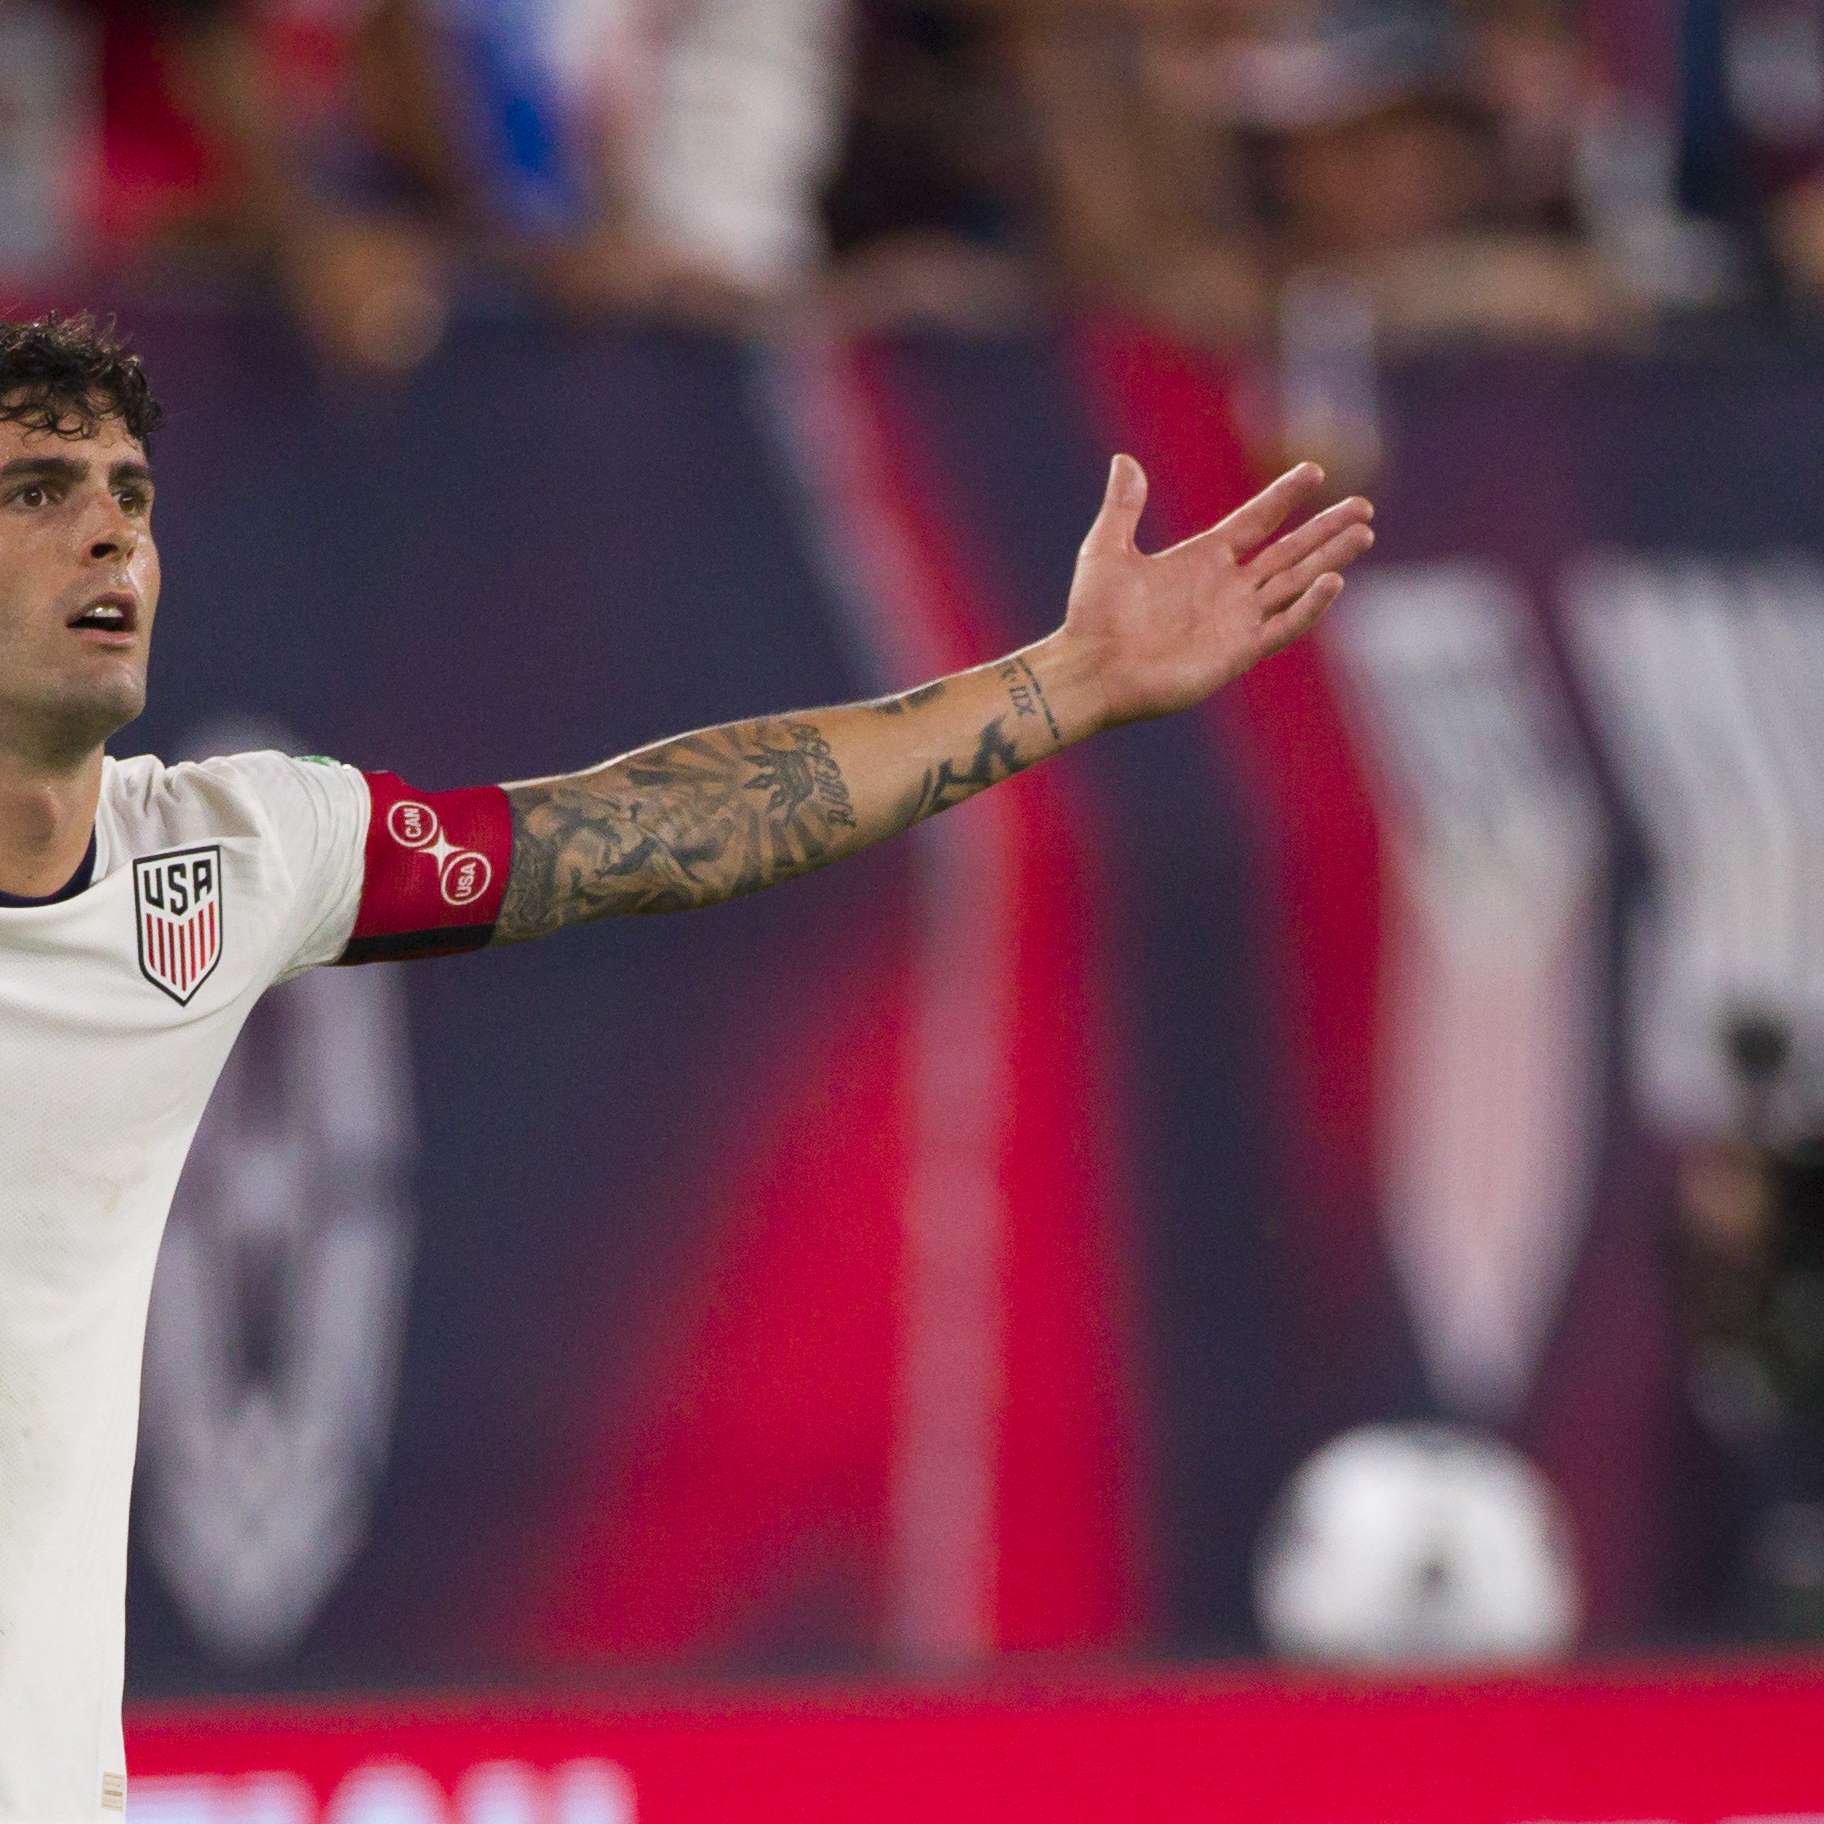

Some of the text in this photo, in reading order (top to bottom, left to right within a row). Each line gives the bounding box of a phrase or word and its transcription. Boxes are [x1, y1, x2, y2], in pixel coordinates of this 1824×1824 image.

[403, 807, 422, 838] CAN
[143, 858, 213, 916] USA
[454, 861, 477, 898] USA
